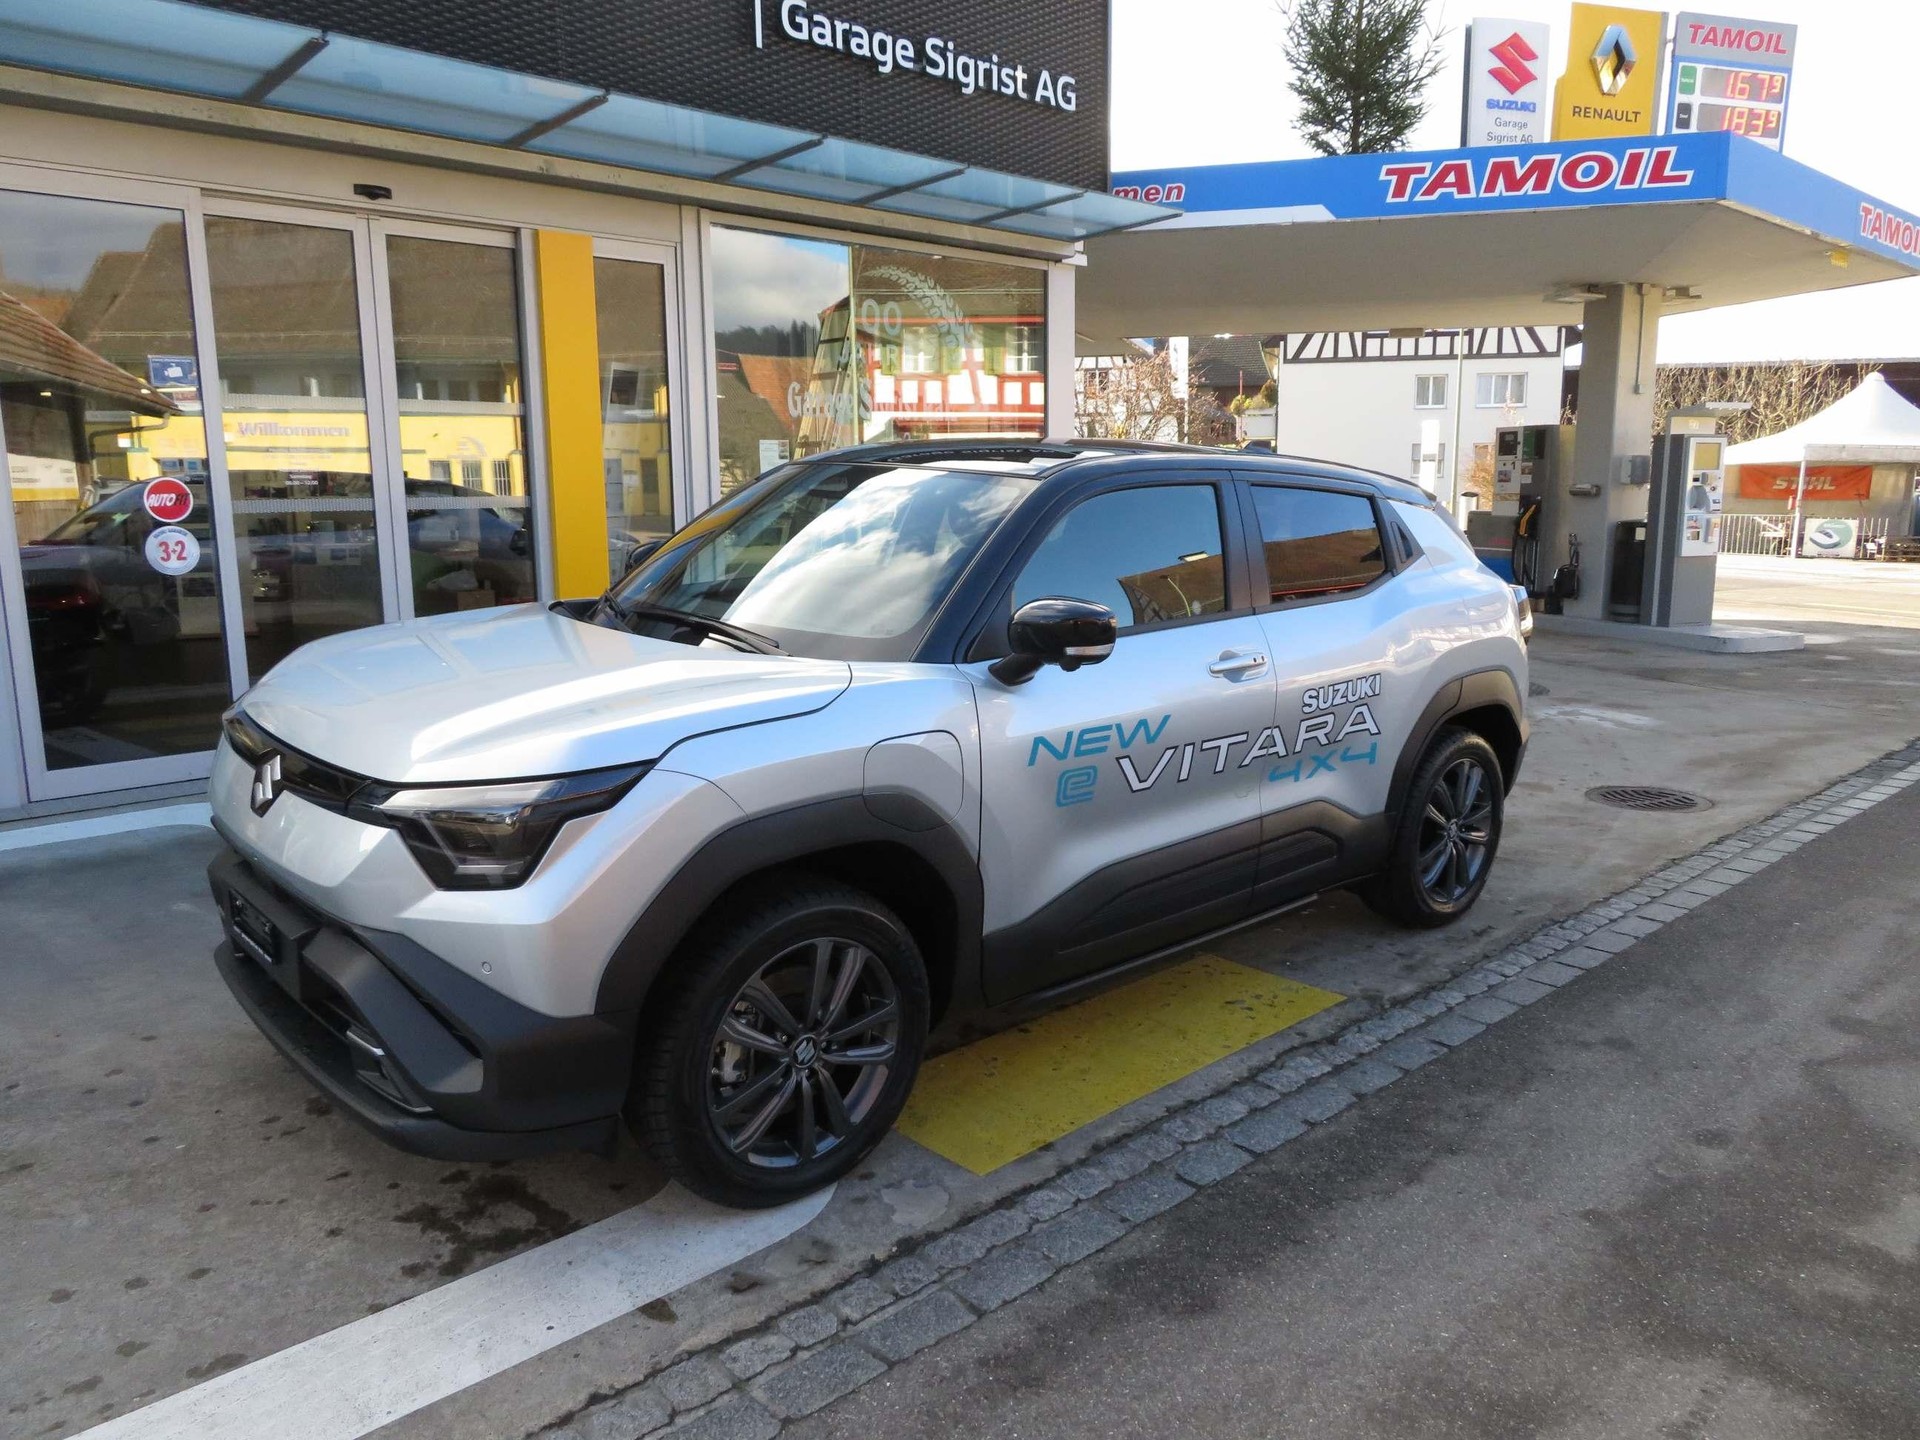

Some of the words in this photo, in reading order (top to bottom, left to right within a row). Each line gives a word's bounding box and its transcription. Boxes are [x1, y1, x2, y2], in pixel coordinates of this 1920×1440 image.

[781, 0, 915, 73] Garage
[925, 37, 1028, 99] Sigrist
[1034, 70, 1077, 111] AG
[1688, 24, 1787, 54] TAMOIL
[1486, 98, 1537, 113] SUZUKI
[1494, 117, 1528, 129] Garage
[1572, 105, 1641, 123] RENAULT
[1487, 132, 1518, 143] Sigrist
[1520, 134, 1533, 143] AG
[1379, 146, 1694, 203] TAMOIL
[1860, 202, 1920, 257] TAMOI
[147, 492, 191, 508] AUTOFIT
[1302, 673, 1382, 714] SUZUKI
[1027, 714, 1171, 767] NEW
[1115, 703, 1382, 794] VITARA
